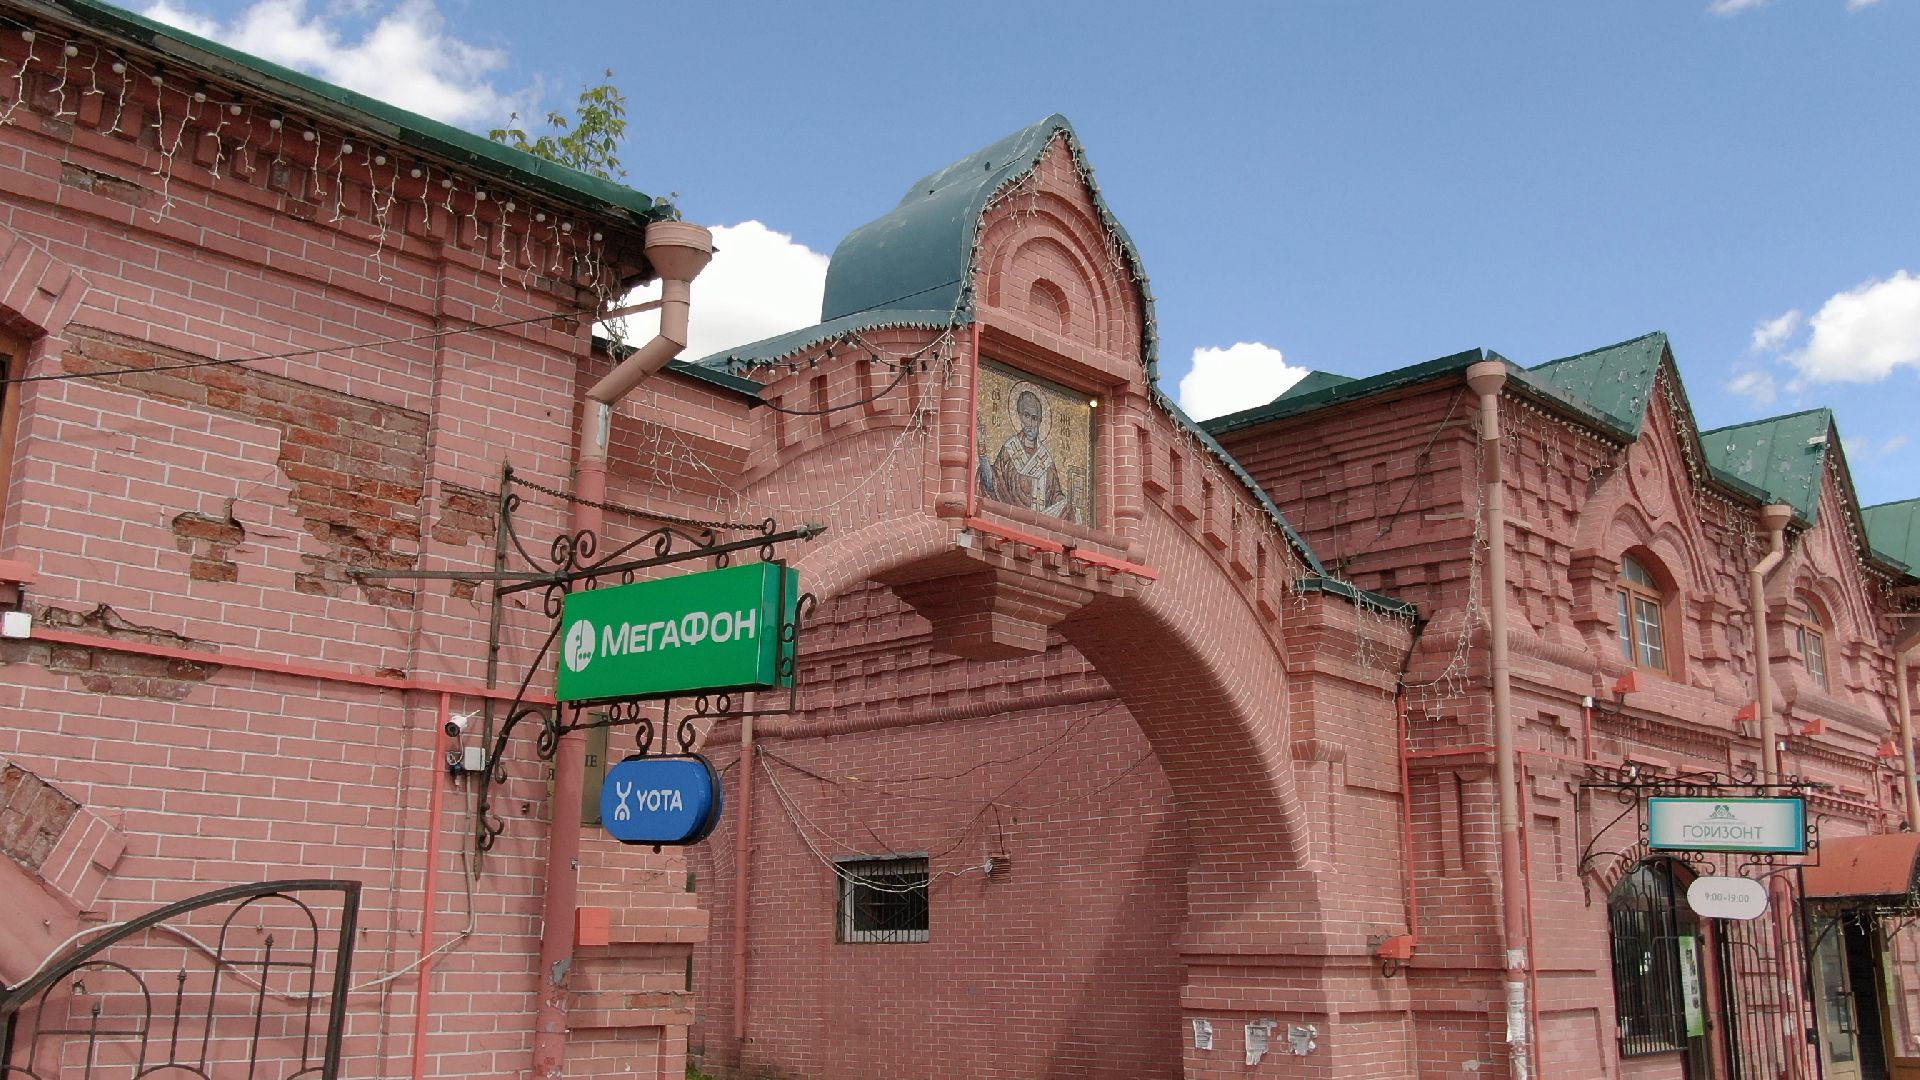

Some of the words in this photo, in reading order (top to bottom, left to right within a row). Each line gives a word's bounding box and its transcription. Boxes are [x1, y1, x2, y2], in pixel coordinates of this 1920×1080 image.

[601, 608, 756, 657] МЕГАФОН
[637, 789, 683, 812] YOTA
[1683, 825, 1764, 840] ГОРИЗОНТ
